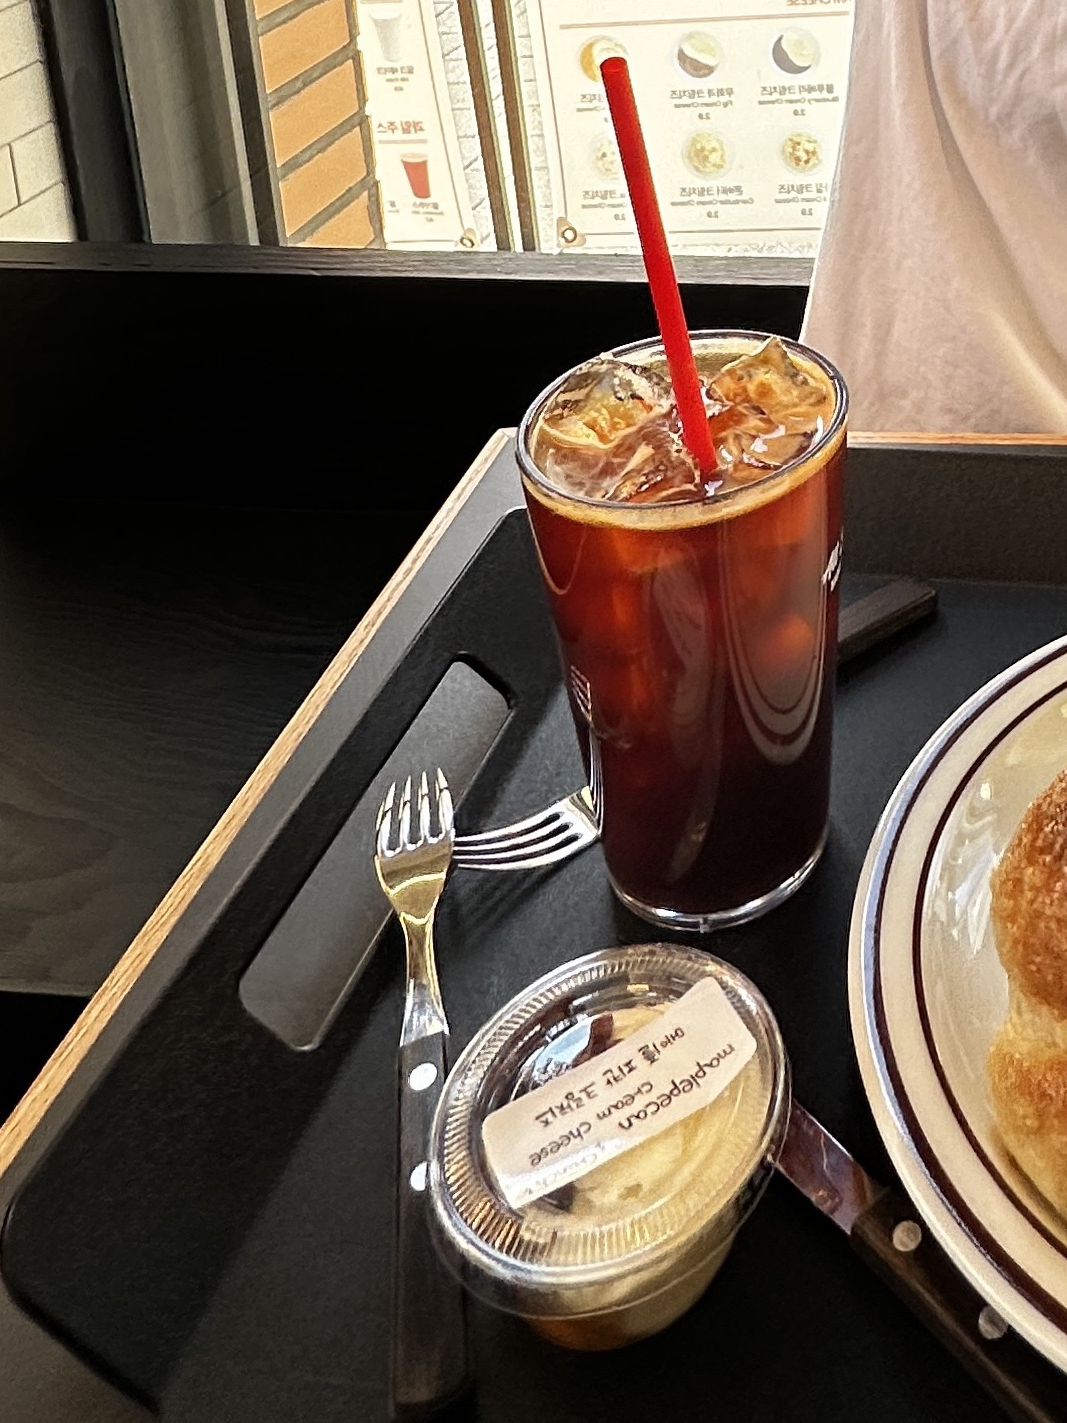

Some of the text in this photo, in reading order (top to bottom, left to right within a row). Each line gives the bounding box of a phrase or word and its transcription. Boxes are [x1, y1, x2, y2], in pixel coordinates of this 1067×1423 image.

[602, 1058, 638, 1088] 피칸
[617, 1042, 735, 1133] maplepecan
[528, 1082, 654, 1167] cream cheese
